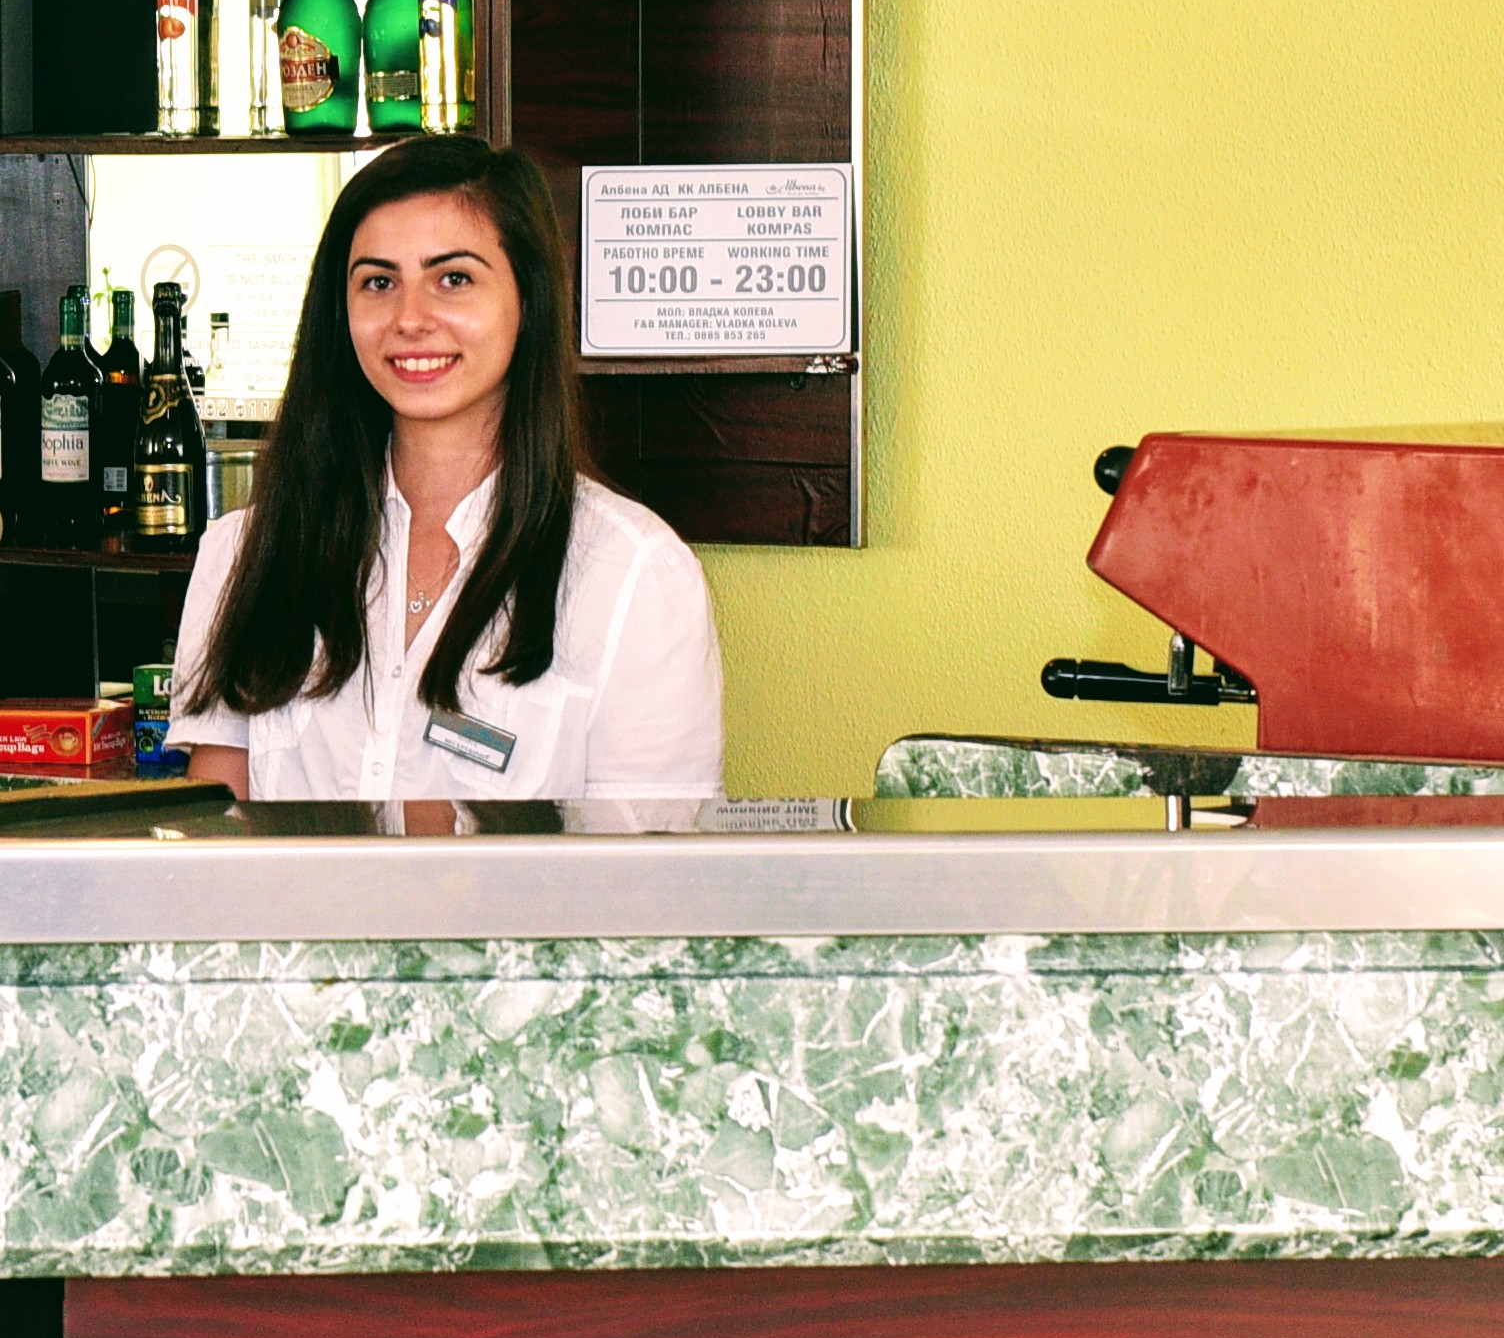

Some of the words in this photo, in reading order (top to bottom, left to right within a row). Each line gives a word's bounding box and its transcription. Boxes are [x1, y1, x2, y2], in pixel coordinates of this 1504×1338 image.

[601, 184, 647, 195] Албена
[652, 185, 669, 196] АД
[678, 184, 694, 194] КК
[698, 184, 748, 194] АЛБЕНА
[621, 207, 662, 219] ЛОБИ
[669, 207, 698, 219] БАР
[737, 207, 786, 218] LOBBY
[792, 206, 822, 217] BAR
[625, 224, 692, 236] КОМПАС
[747, 223, 812, 235] KOMPAS
[603, 247, 659, 259] РАБОТНО
[663, 247, 705, 258] ВРЕМЕ
[728, 246, 791, 258] WORKING
[795, 246, 829, 257] TIME
[609, 265, 698, 294] 10:00
[710, 278, 722, 286] -
[735, 265, 826, 293] 23:00
[689, 308, 729, 318] ВЛАДКА
[733, 307, 774, 316] КОЛЕВА
[634, 320, 654, 328] F&B
[659, 319, 712, 328] MANAGER:
[716, 319, 755, 328] VLADKA
[759, 319, 797, 328] KOLEVA
[665, 331, 690, 340] ТЕЛ.:
[724, 331, 742, 340] 853
[746, 331, 766, 340] 265
